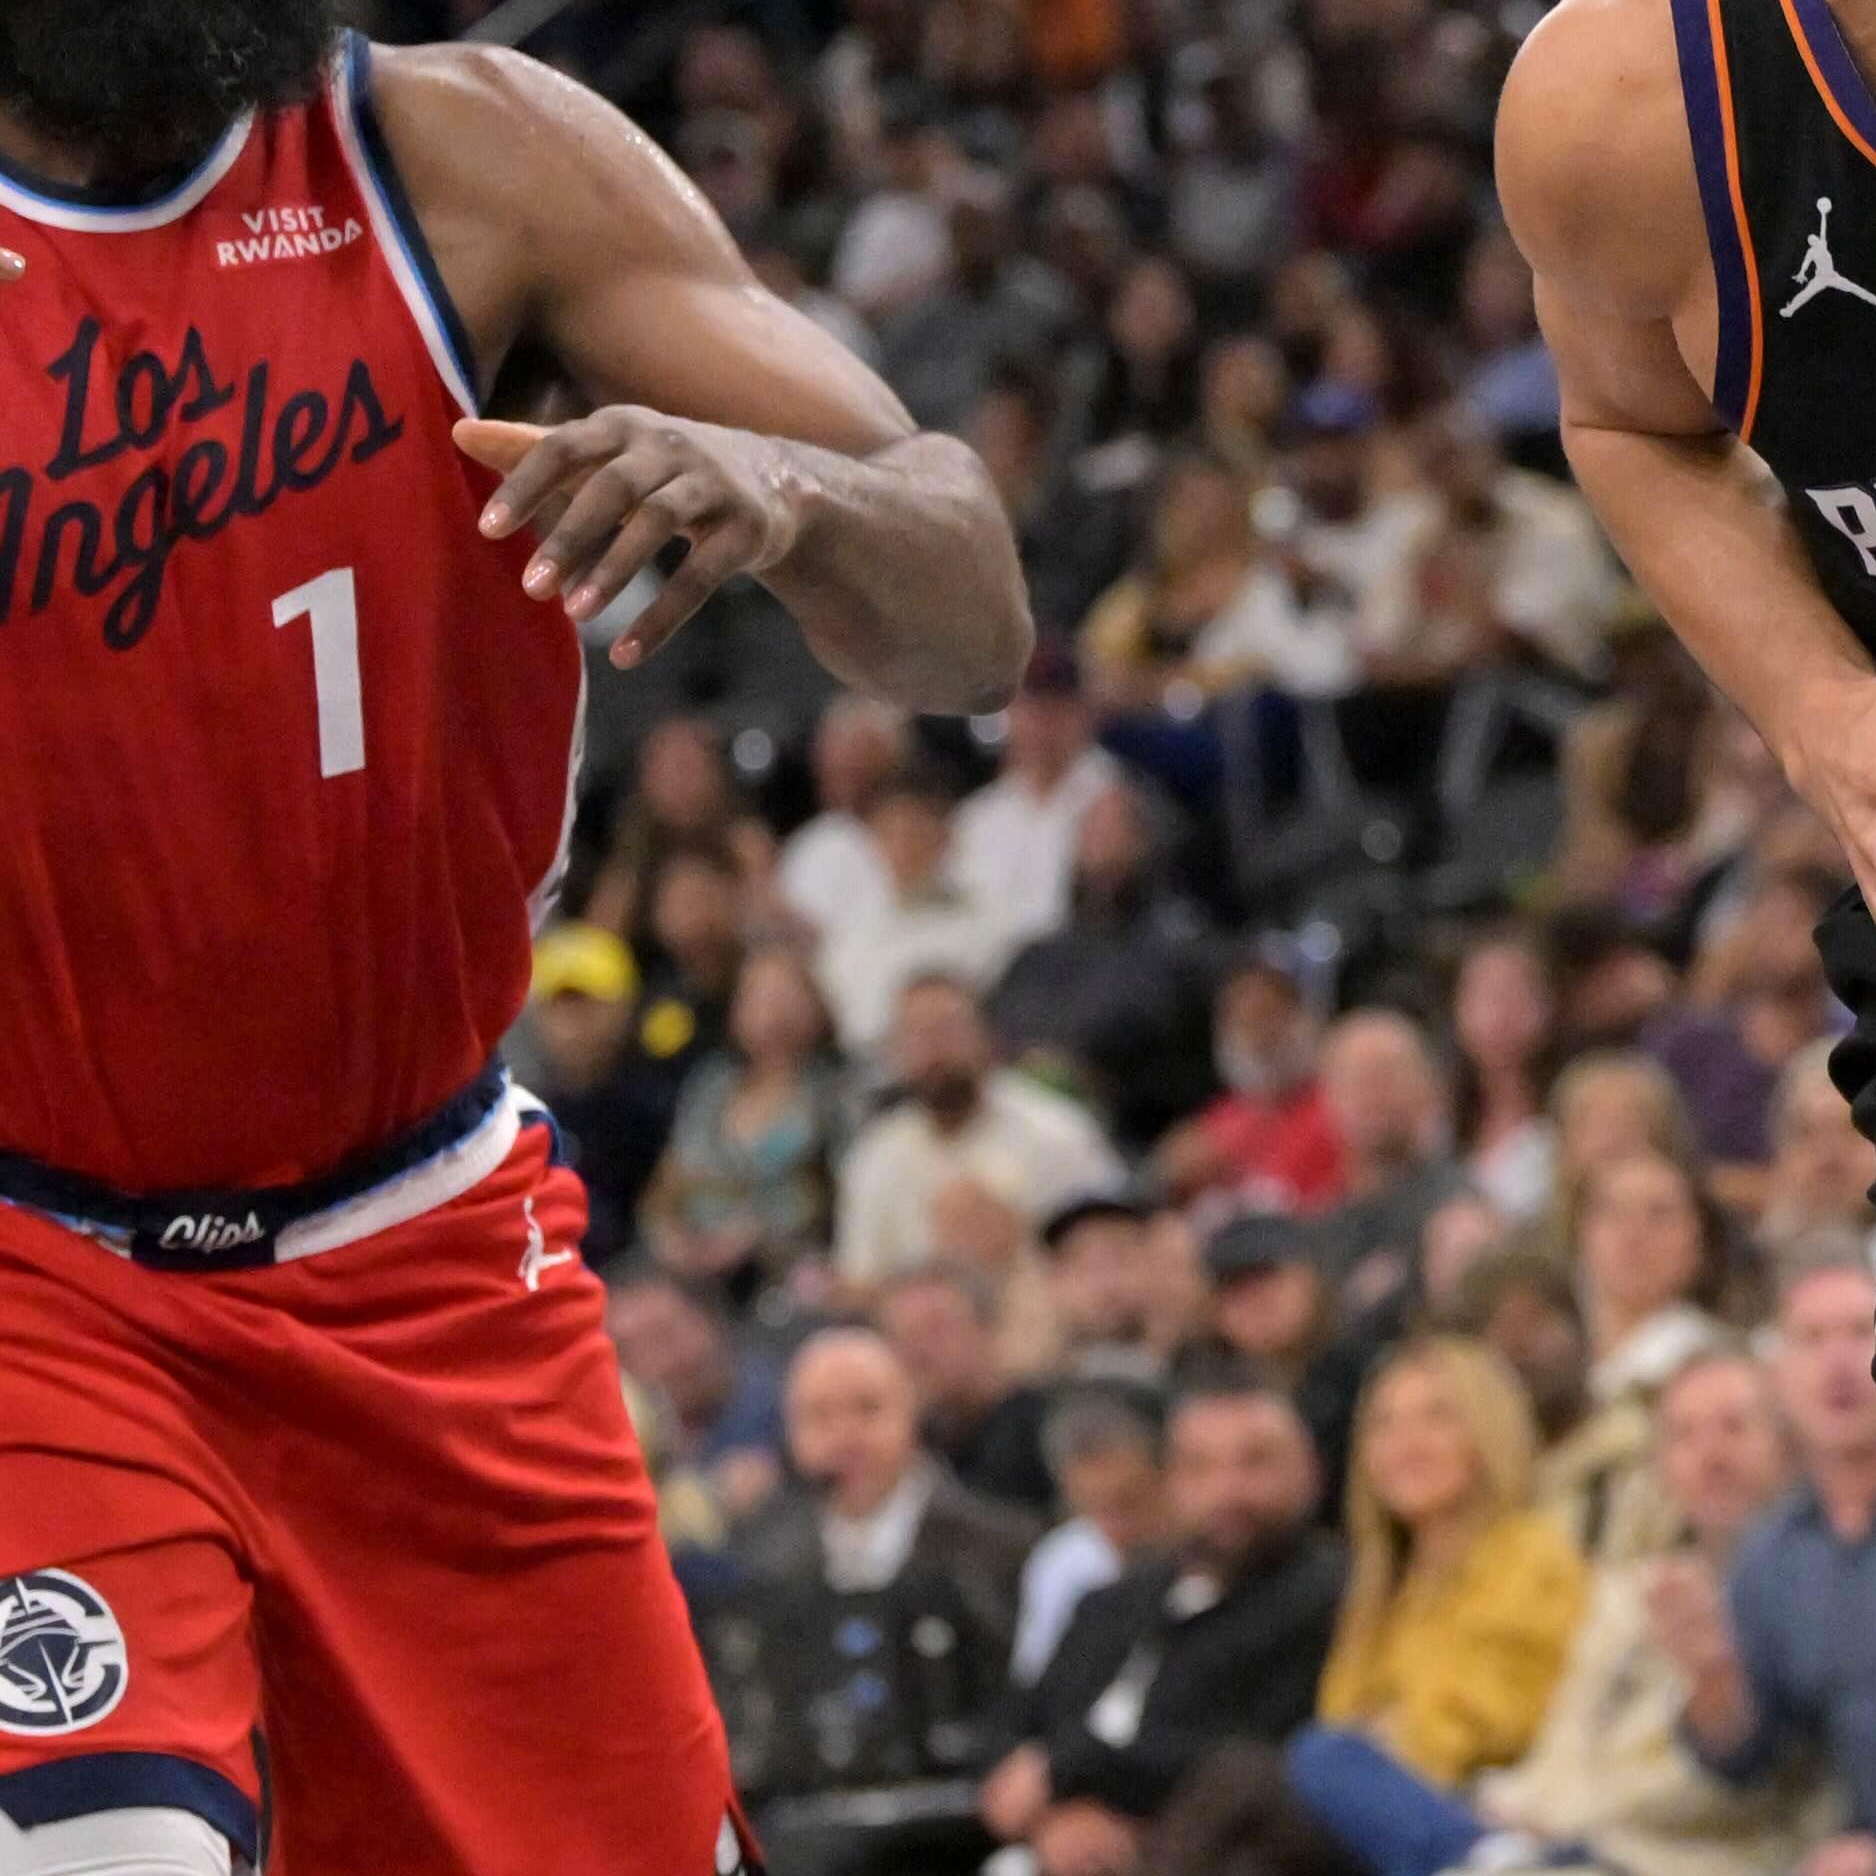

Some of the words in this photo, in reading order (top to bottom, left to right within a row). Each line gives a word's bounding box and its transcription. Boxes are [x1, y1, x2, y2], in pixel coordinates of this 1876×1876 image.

[217, 217, 364, 268] RWANDA
[242, 205, 325, 233] VISIT
[46, 315, 235, 480] Los
[271, 566, 365, 779] 1
[159, 1210, 266, 1254] Clips
